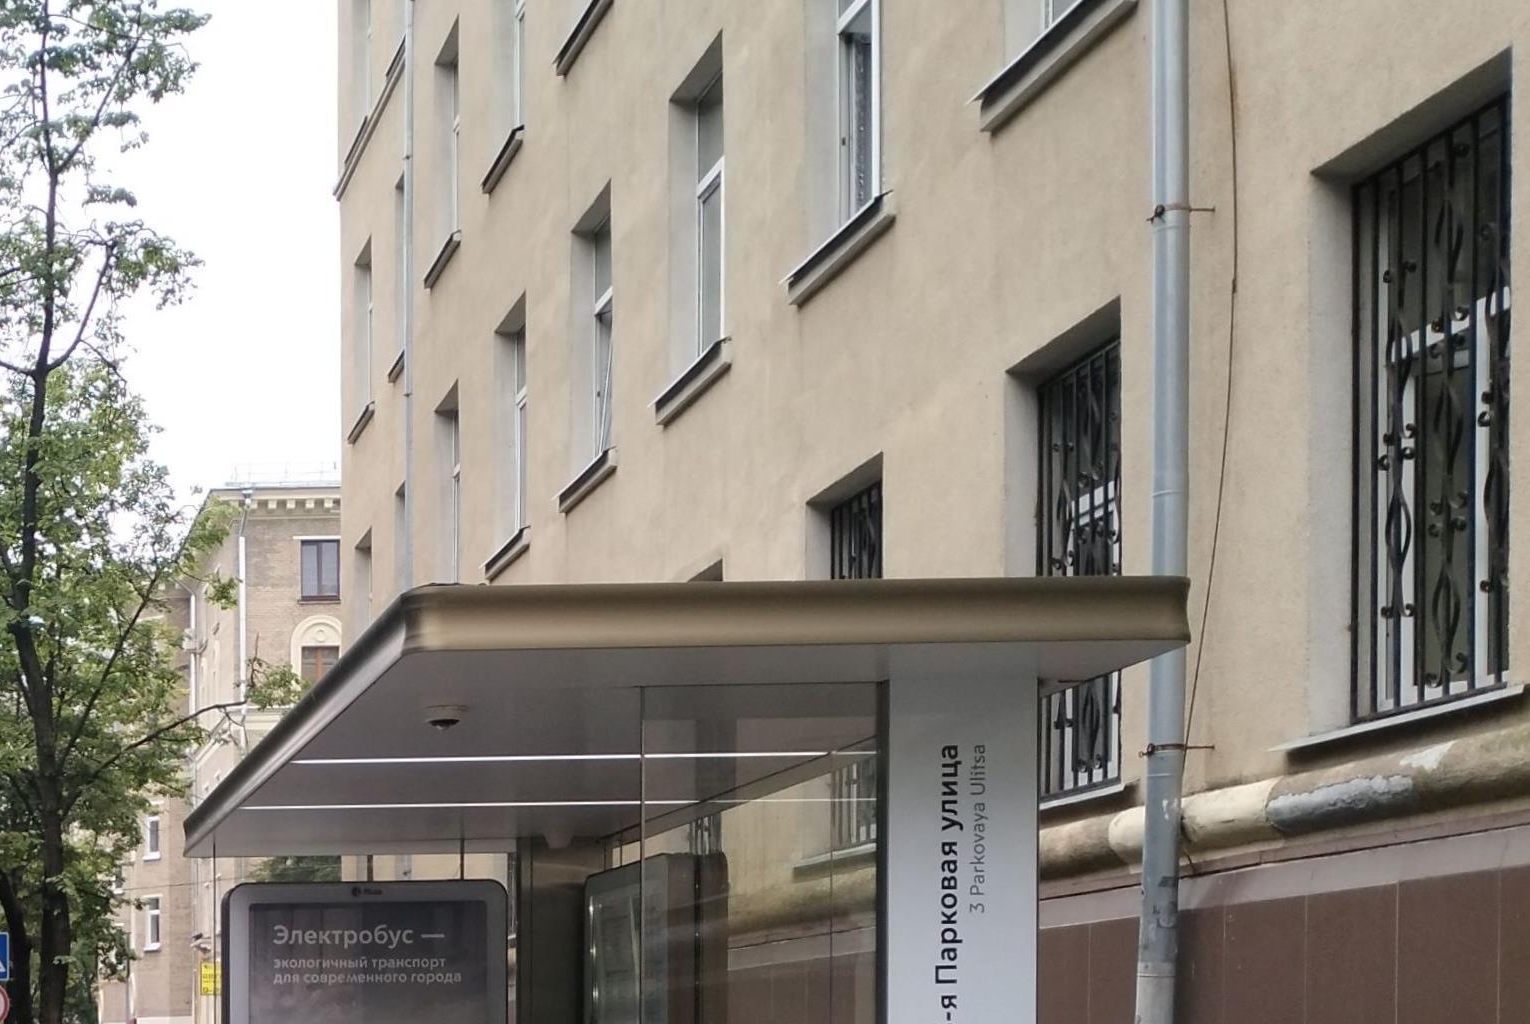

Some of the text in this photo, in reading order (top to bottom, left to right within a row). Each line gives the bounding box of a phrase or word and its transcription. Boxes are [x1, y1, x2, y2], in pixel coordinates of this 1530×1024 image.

[940, 744, 963, 832] улица
[969, 744, 989, 914] 3 Parkovaya Ulitsa
[273, 924, 414, 949] Электробус
[934, 841, 963, 984] Парковая
[273, 956, 446, 970] экологичный транспорт
[273, 972, 462, 985] для современного города
